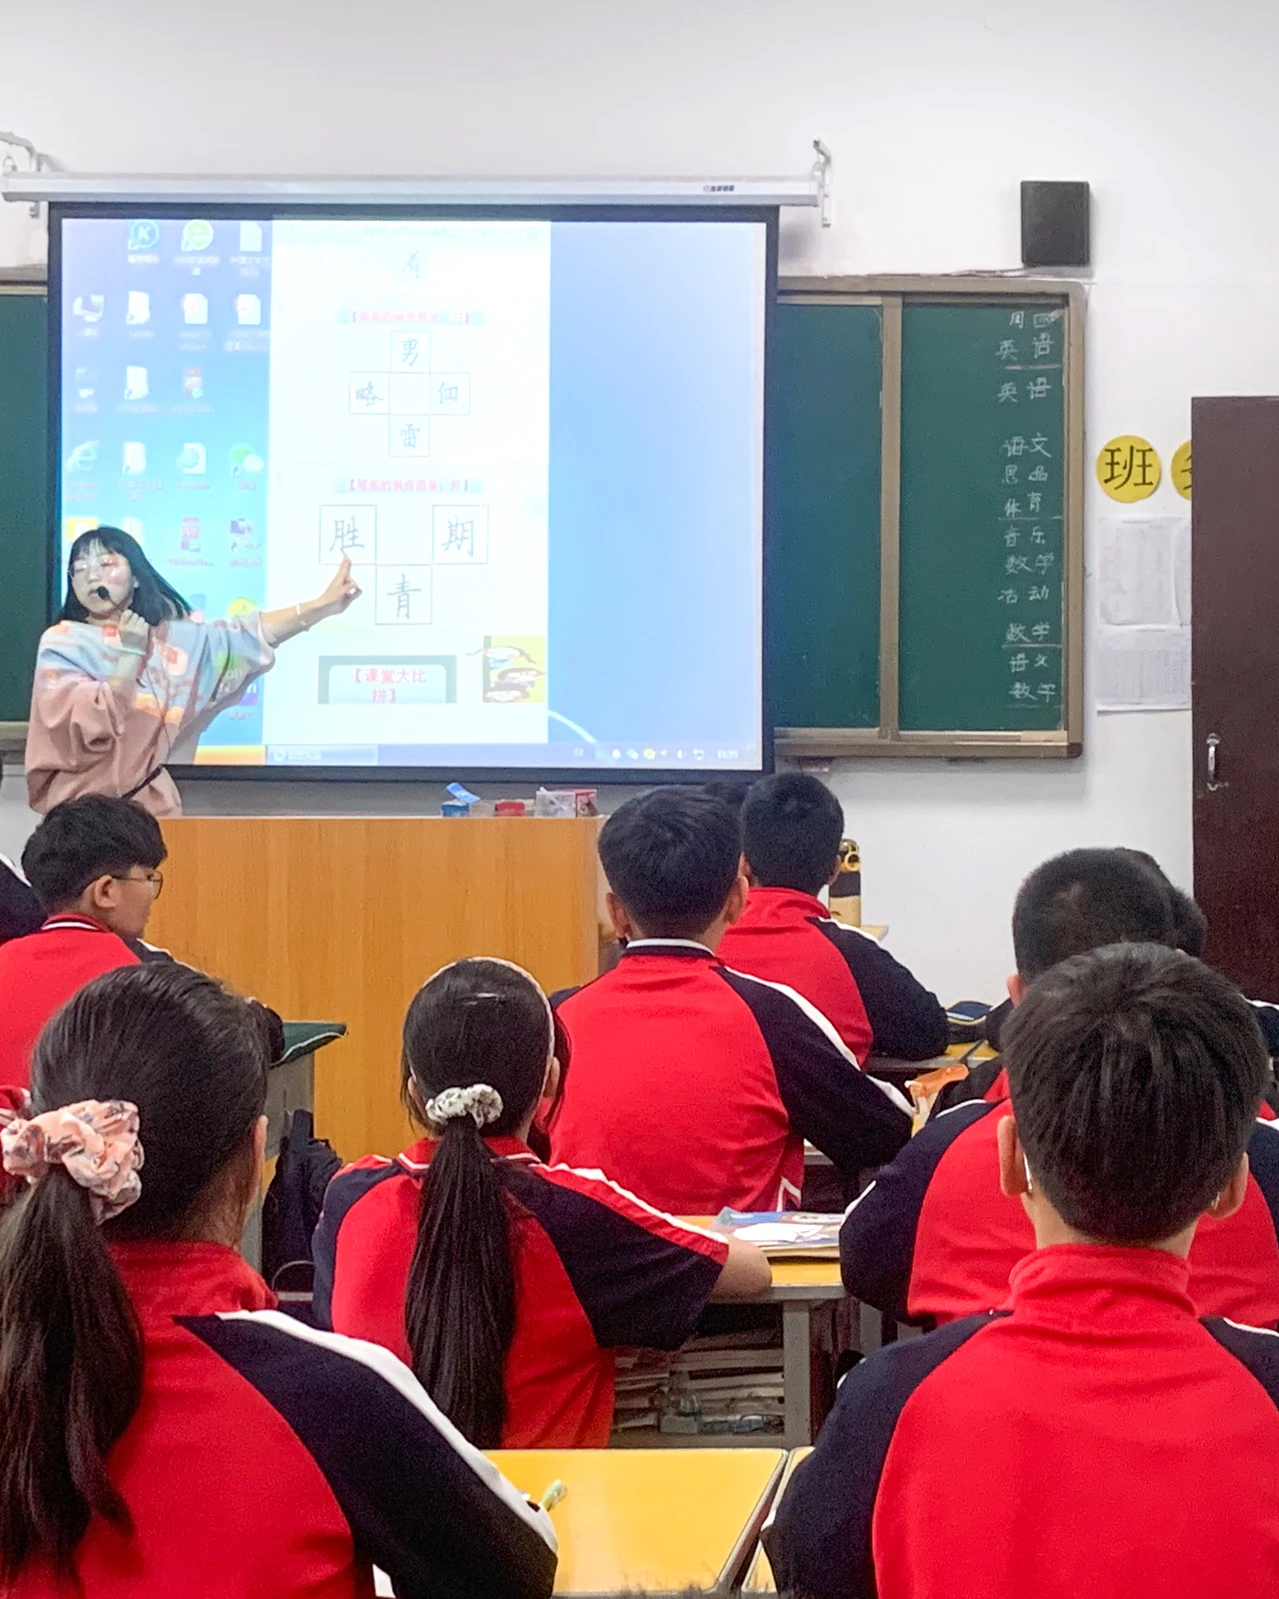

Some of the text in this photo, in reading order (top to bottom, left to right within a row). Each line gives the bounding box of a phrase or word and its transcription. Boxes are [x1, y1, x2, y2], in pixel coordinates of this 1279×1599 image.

[401, 338, 419, 367] 男
[995, 333, 1054, 361] 英语
[355, 381, 384, 407] 略
[997, 377, 1052, 403] 英语
[400, 423, 420, 449] 雷
[1004, 432, 1052, 458] 语文
[1003, 492, 1043, 518] 体育
[329, 516, 366, 552] 胜
[442, 515, 475, 557] 期
[1004, 526, 1047, 548] 音乐
[1005, 552, 1055, 575] 数学
[386, 573, 422, 620] 青
[997, 585, 1050, 605] 活动
[1006, 622, 1051, 644] 数学
[1009, 653, 1049, 674] 语文
[1009, 682, 1057, 703] 数学
